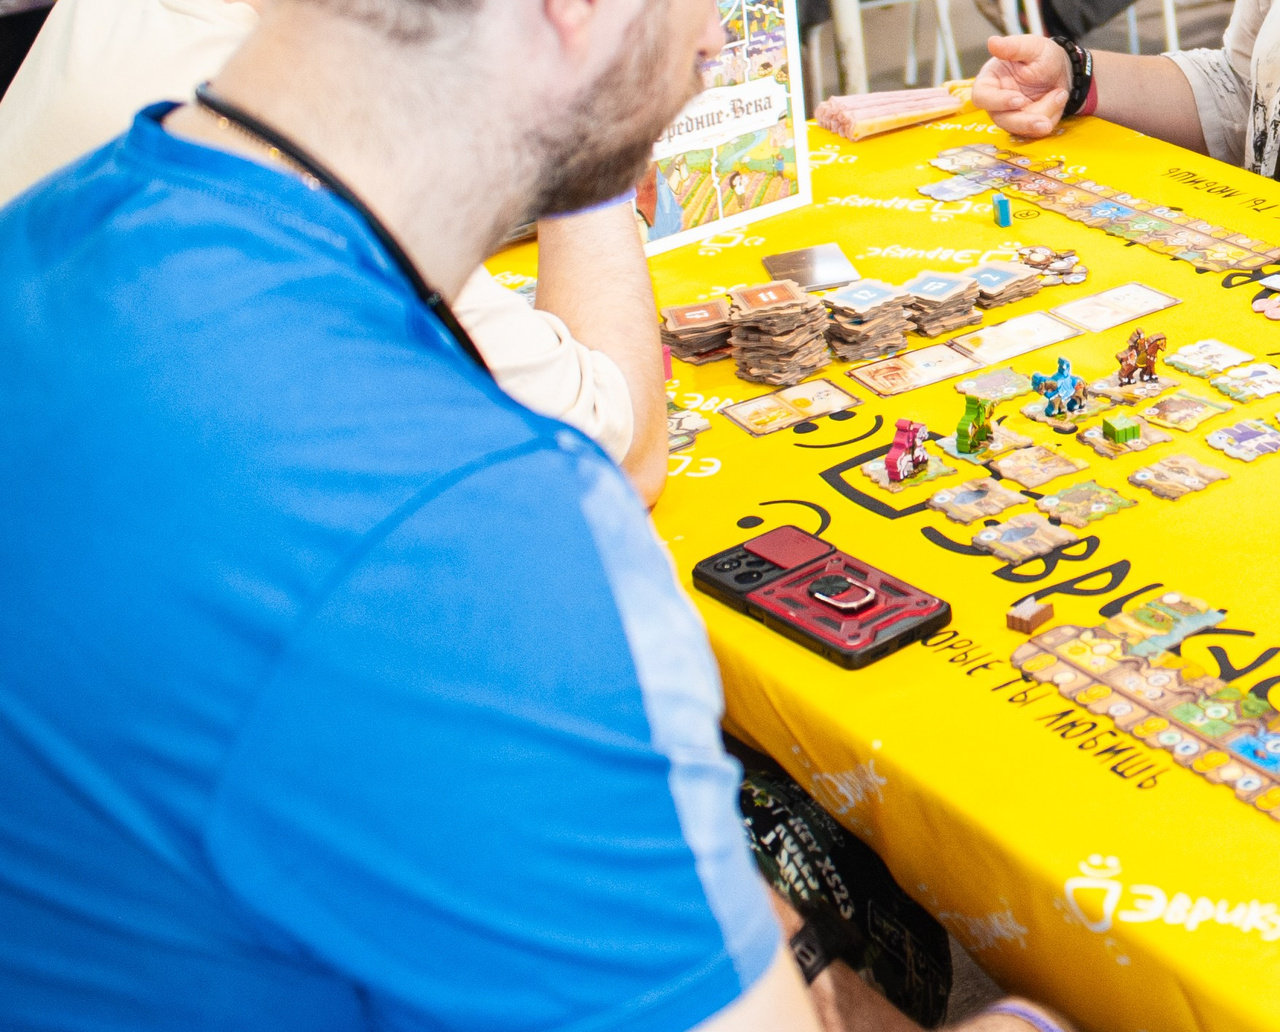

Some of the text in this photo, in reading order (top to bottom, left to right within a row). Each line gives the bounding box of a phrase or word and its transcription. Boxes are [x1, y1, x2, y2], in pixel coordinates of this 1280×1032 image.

[1162, 166, 1244, 199] ЛЮБИШЬ
[1238, 197, 1280, 213] ТЫ
[921, 629, 1004, 676] ОРЫЕ
[1034, 709, 1170, 790] ЛЮБИШЬ
